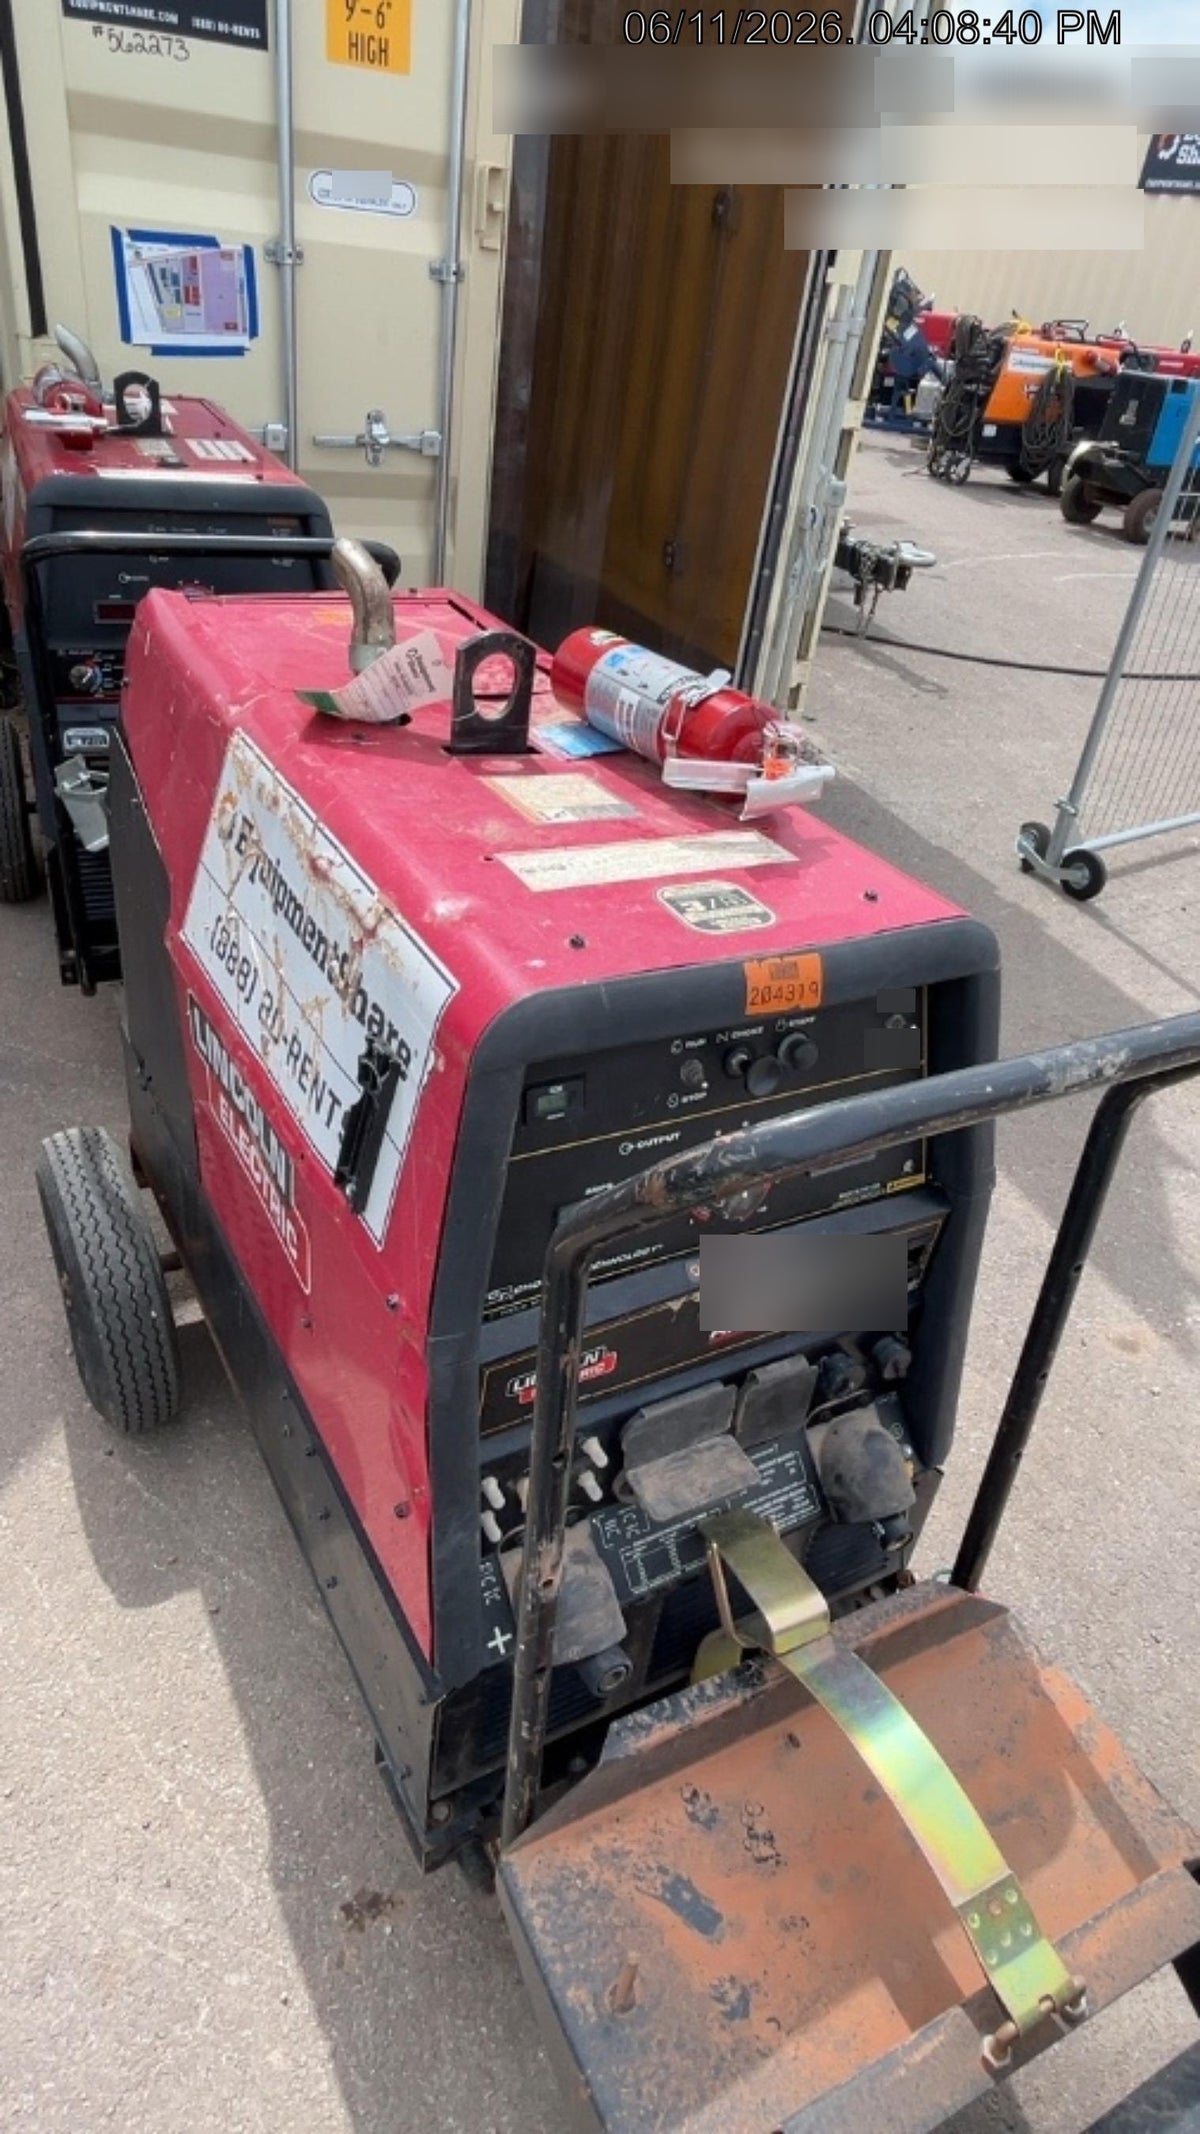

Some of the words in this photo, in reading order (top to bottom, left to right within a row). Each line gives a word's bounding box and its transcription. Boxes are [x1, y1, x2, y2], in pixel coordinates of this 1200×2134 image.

[348, 31, 390, 67] HIGH
[210, 915, 260, 1004] (888)
[189, 999, 294, 1204] LINCOLN
[637, 1131, 682, 1149] OUTPUT
[218, 1095, 299, 1261] ELECTRIC
